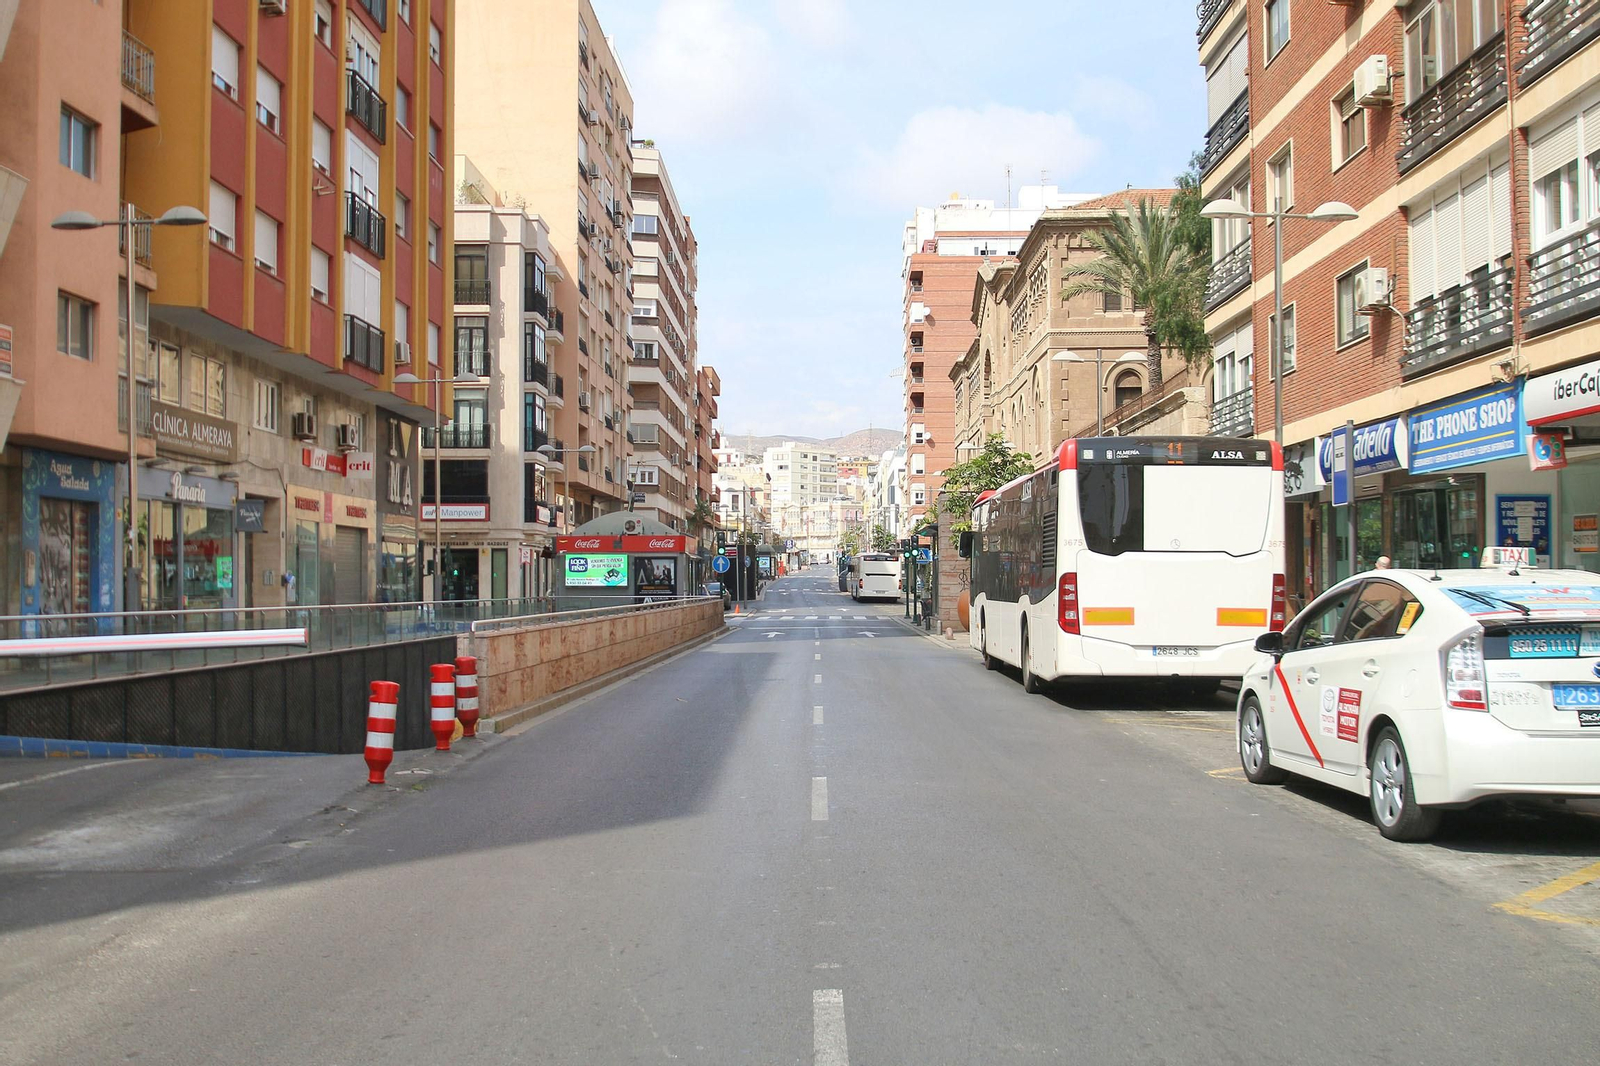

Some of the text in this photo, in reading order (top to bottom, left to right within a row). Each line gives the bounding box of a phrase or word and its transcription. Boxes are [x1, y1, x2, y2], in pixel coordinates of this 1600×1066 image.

[1412, 397, 1515, 444] THE PHONE SHOP
[153, 409, 233, 448] CLÍNICA ALMERAYA
[1167, 442, 1184, 464] 11
[1211, 450, 1244, 459] ALSA
[349, 460, 371, 471] crit
[172, 472, 206, 503] Panaria
[441, 508, 483, 518] Manpower
[1063, 539, 1084, 547] 3675
[1502, 549, 1528, 561] TAXI
[1158, 647, 1198, 655] 2648 JCS
[1512, 640, 1532, 652] 950
[1534, 640, 1548, 652] 25
[1550, 640, 1562, 651] 11
[1566, 640, 1578, 651] 11
